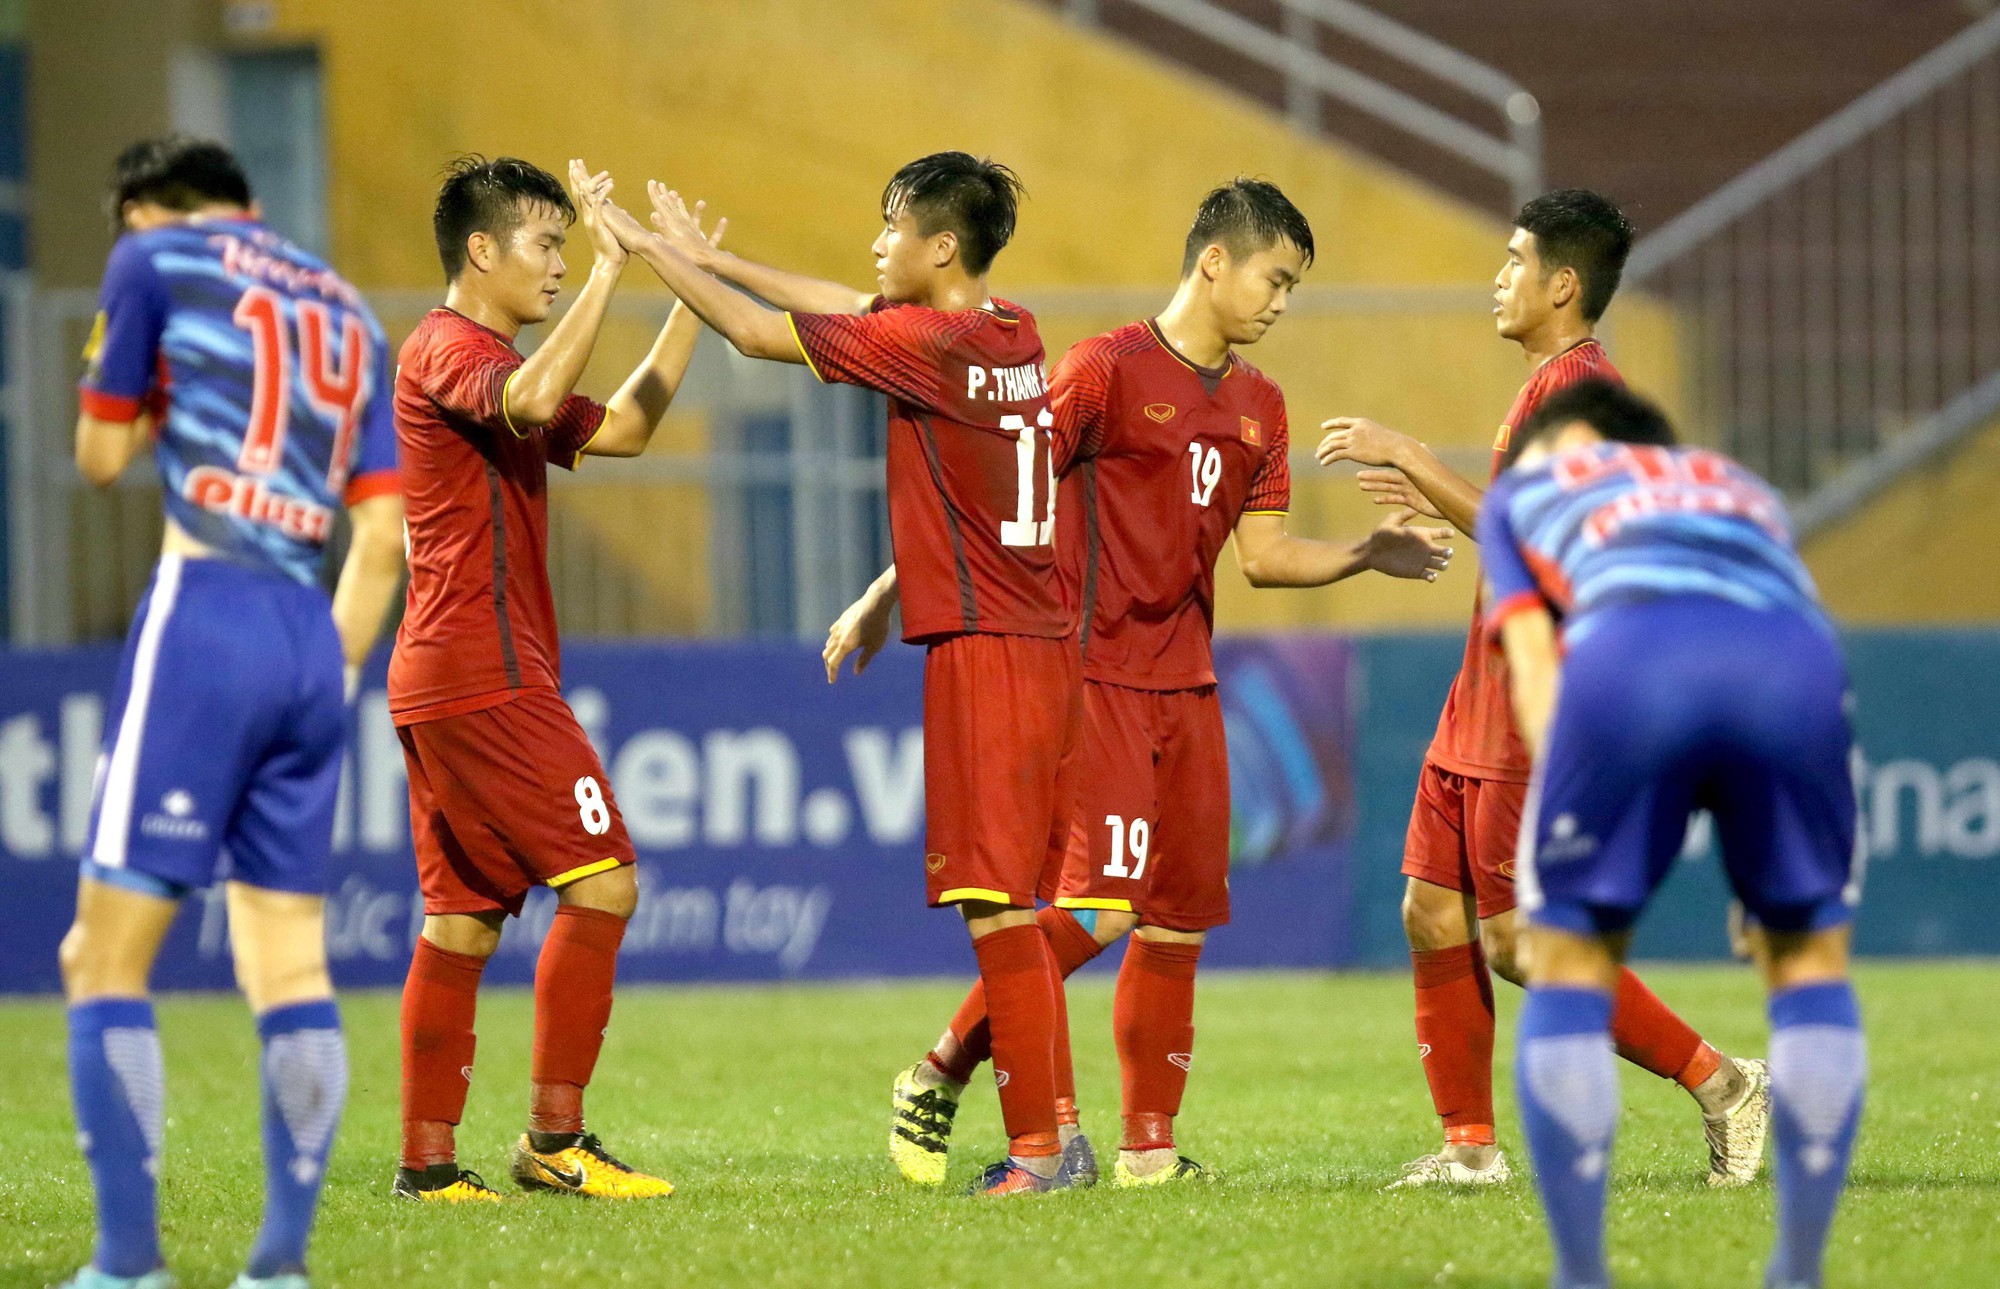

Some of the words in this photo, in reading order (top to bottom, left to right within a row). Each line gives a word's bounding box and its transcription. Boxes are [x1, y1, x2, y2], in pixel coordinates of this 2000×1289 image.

[233, 285, 363, 497] 14
[967, 363, 1042, 402] P.THANH
[1188, 441, 1222, 507] 19
[574, 775, 610, 836] 8
[1103, 814, 1149, 880] 19
